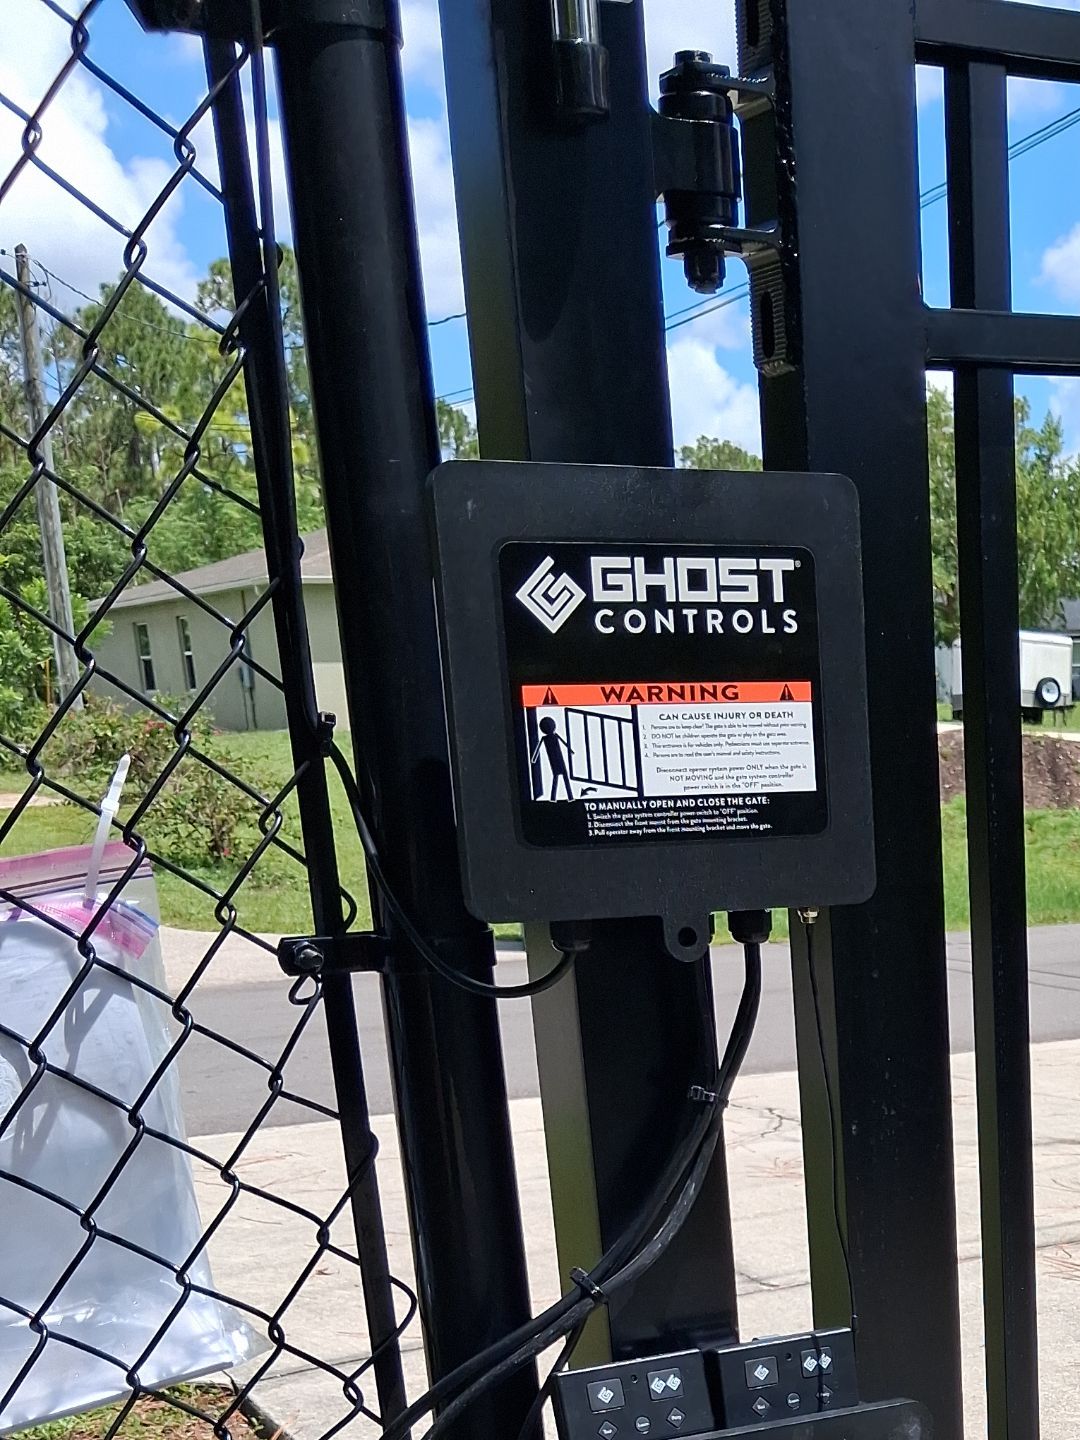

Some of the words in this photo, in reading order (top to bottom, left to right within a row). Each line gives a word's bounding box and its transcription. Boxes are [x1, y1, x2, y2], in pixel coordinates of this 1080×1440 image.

[590, 556, 795, 603] GHOST
[594, 609, 798, 633] CONTROLS
[600, 685, 739, 703] WARNING
[659, 713, 679, 721] CAN
[682, 712, 711, 721] CAUSE
[714, 712, 746, 720] INJURY
[749, 711, 761, 719] OR
[765, 711, 793, 719] DEATH
[584, 802, 597, 811] TO
[598, 800, 647, 811] MANUALLY
[649, 799, 674, 809] OPEN
[676, 798, 695, 808] AND
[697, 797, 726, 807] CLOSE
[727, 797, 744, 806] THE
[745, 796, 770, 805] GATE:
